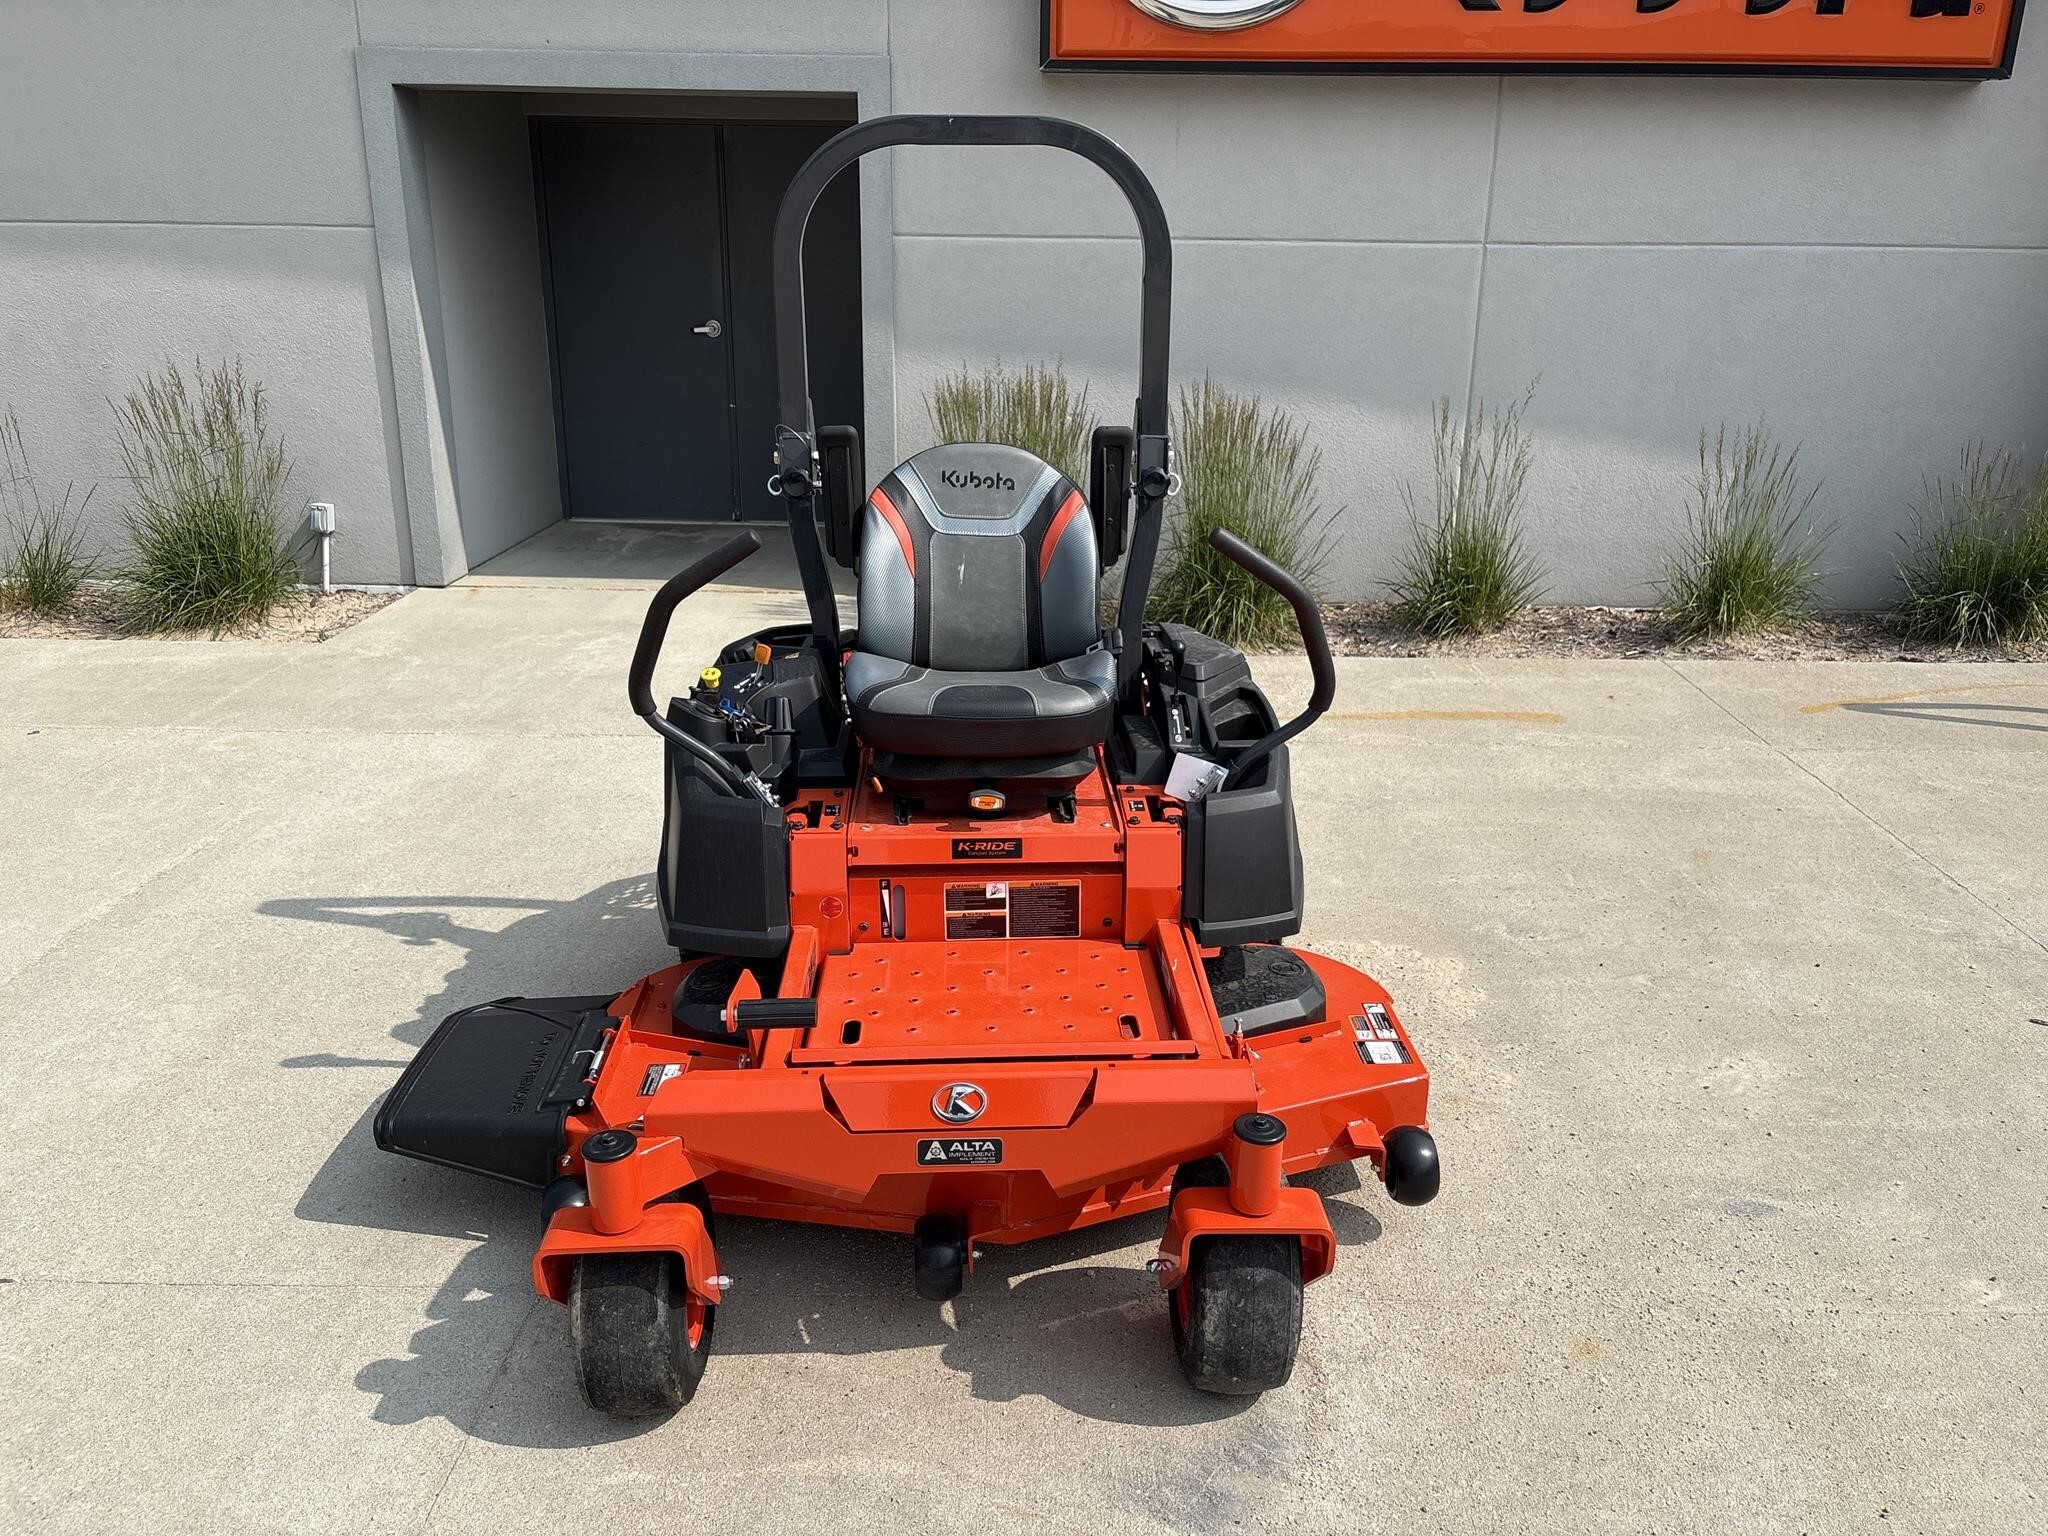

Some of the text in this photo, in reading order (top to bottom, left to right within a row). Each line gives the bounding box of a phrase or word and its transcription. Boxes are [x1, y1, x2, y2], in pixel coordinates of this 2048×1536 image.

[941, 470, 1015, 491] Kubota
[957, 841, 1016, 851] K-RIDE
[881, 880, 888, 888] F
[883, 928, 890, 936] E
[949, 1141, 996, 1152] ALTA
